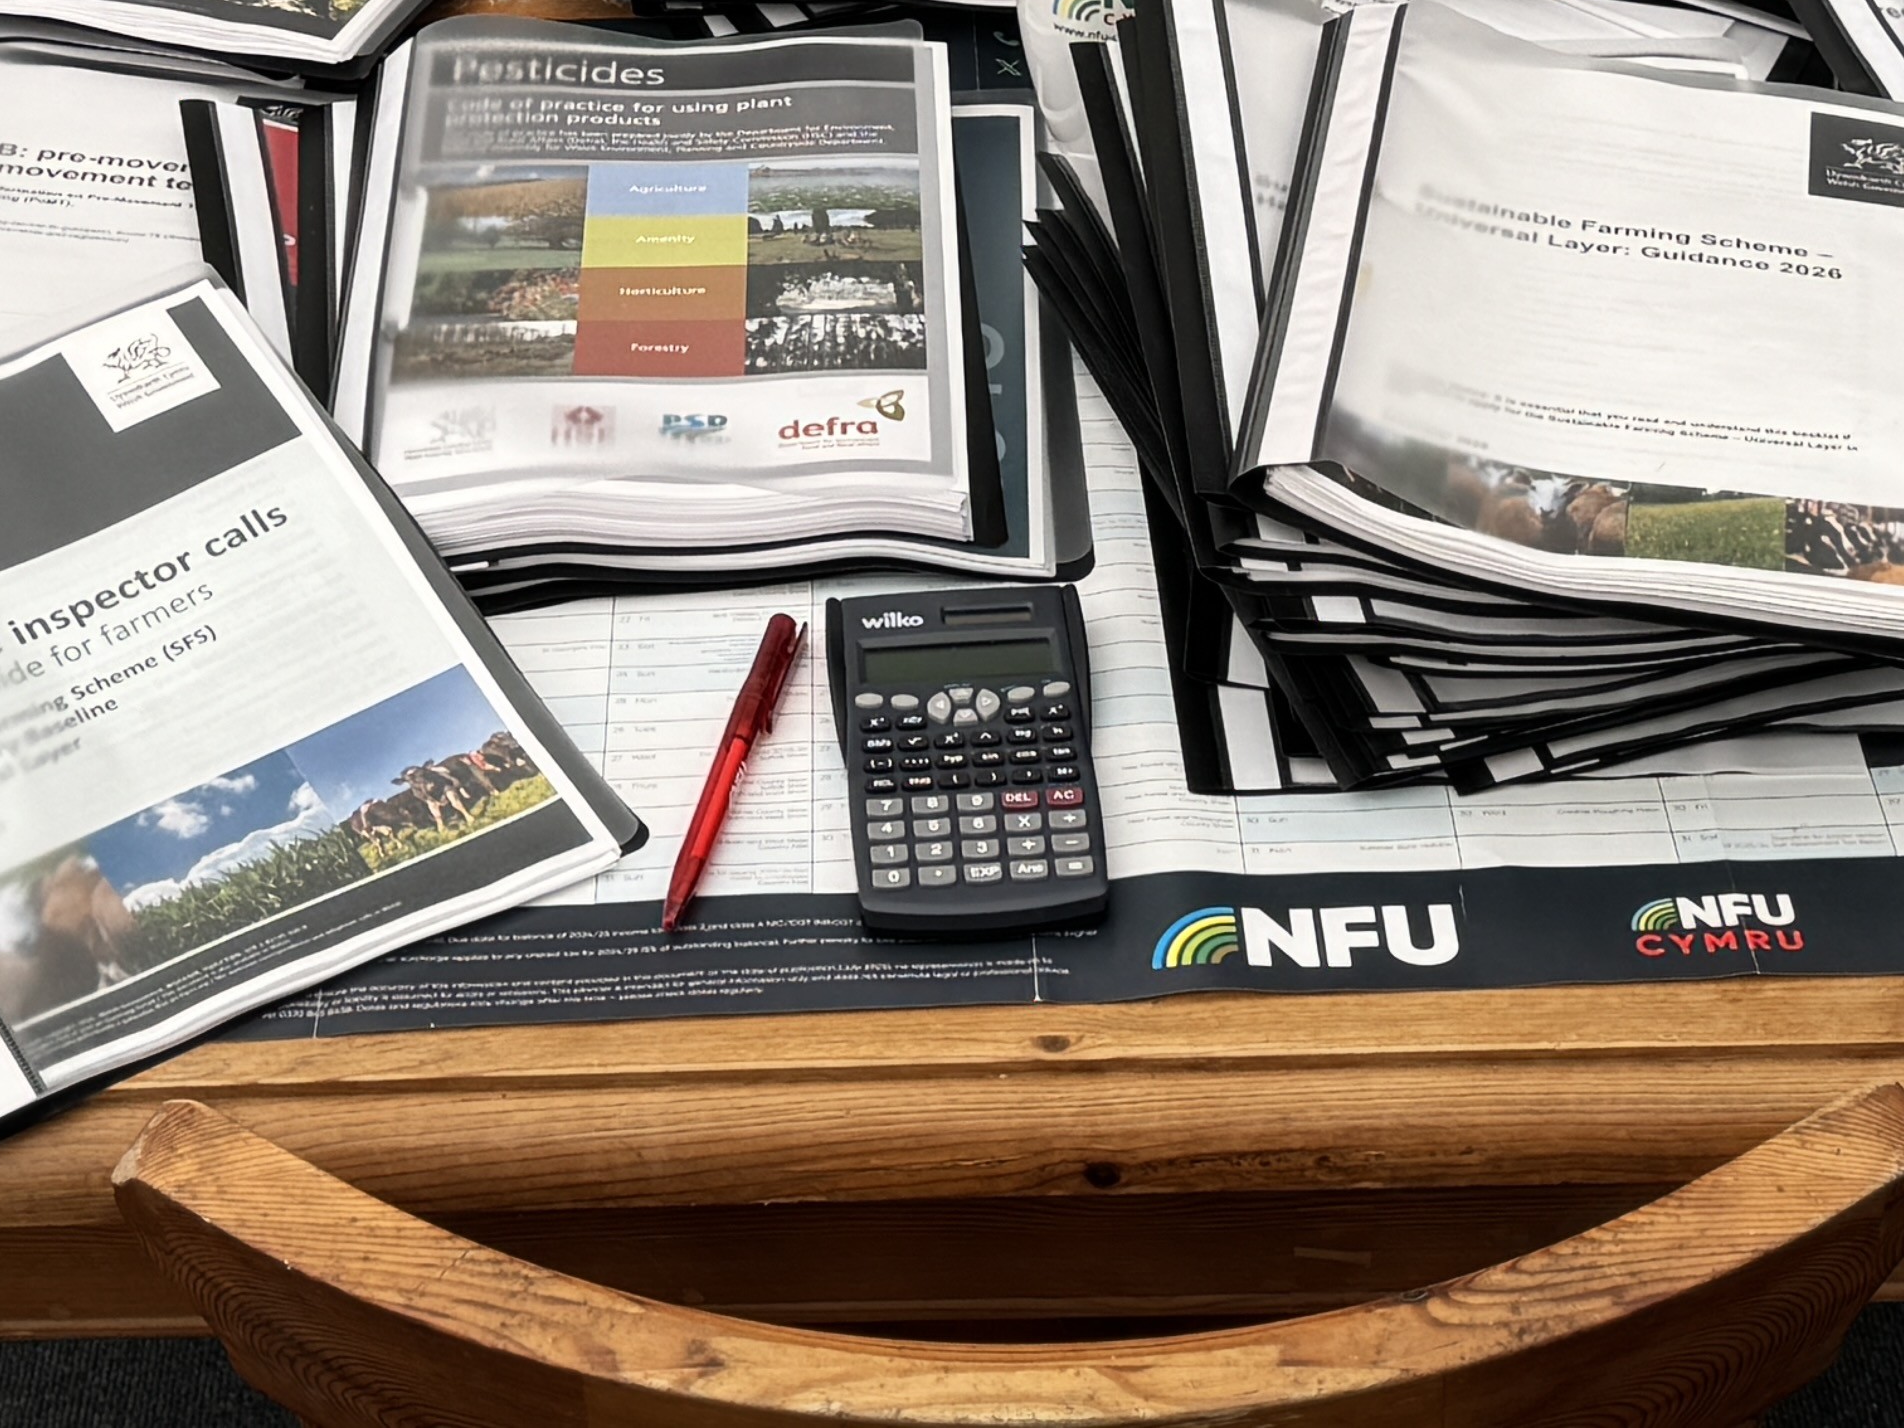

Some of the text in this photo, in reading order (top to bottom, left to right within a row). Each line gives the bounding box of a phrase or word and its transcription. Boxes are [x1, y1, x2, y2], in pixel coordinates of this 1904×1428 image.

[453, 58, 665, 86] Pesticides
[540, 97, 624, 114] practice
[633, 102, 664, 114] for
[672, 100, 728, 114] using
[737, 96, 793, 112] plant
[567, 112, 660, 127] products
[630, 184, 706, 194] Agriculture
[636, 235, 695, 244] Amenity
[1581, 220, 1691, 245] Farming
[1700, 232, 1809, 258] Scheme
[1547, 234, 1631, 257] Layer:
[1641, 246, 1770, 271] Guidance
[1779, 262, 1843, 281] 2026
[620, 286, 706, 295] Horticulture
[630, 344, 689, 354] Forestry
[778, 417, 878, 440] defra
[7, 549, 191, 646] inspector
[204, 503, 289, 557] calls
[50, 637, 92, 668] for
[100, 580, 213, 646] farmers
[862, 612, 924, 630] wilko
[70, 654, 158, 701] Scheme
[162, 625, 218, 664] (SFS)
[24, 698, 118, 744] Baseline
[1006, 791, 1074, 802] DEL AC
[1241, 893, 1796, 969] NFU NFU
[1636, 930, 1805, 956] CYMRU
